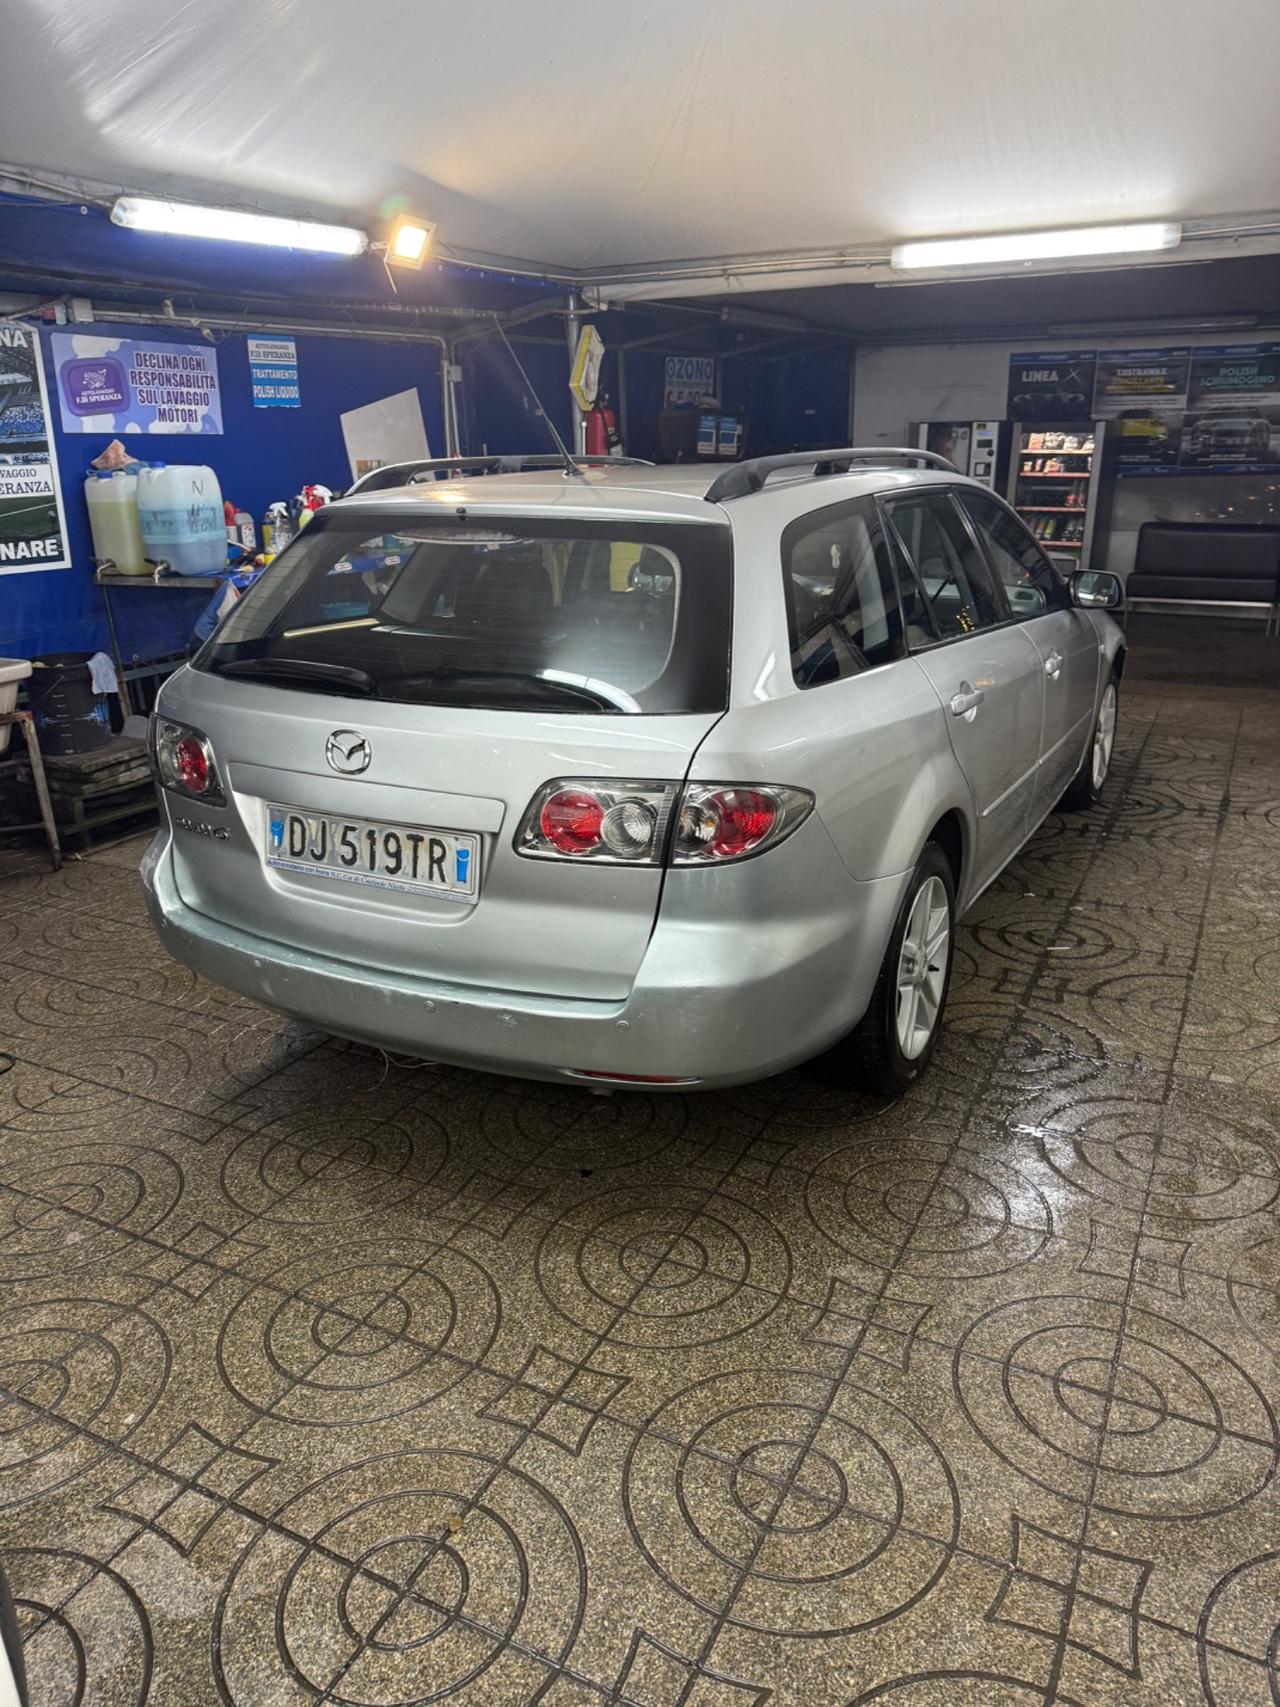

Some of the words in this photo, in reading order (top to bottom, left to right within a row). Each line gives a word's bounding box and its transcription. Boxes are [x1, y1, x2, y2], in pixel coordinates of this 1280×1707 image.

[135, 352, 179, 371] DECLINA
[181, 356, 206, 372] OGNI
[666, 358, 713, 381] OZONO
[252, 368, 298, 380] TRATTAMENTO
[1021, 370, 1059, 382] LINEA
[1219, 366, 1259, 377] POLISH
[88, 392, 123, 404] SPERANZA
[139, 388, 160, 405] SUL
[160, 390, 210, 407] LAVAGGIO
[253, 385, 275, 399] POLISH
[275, 385, 299, 399] LIQUIDO
[157, 406, 199, 424] MOTORI
[0, 539, 59, 561] NARE
